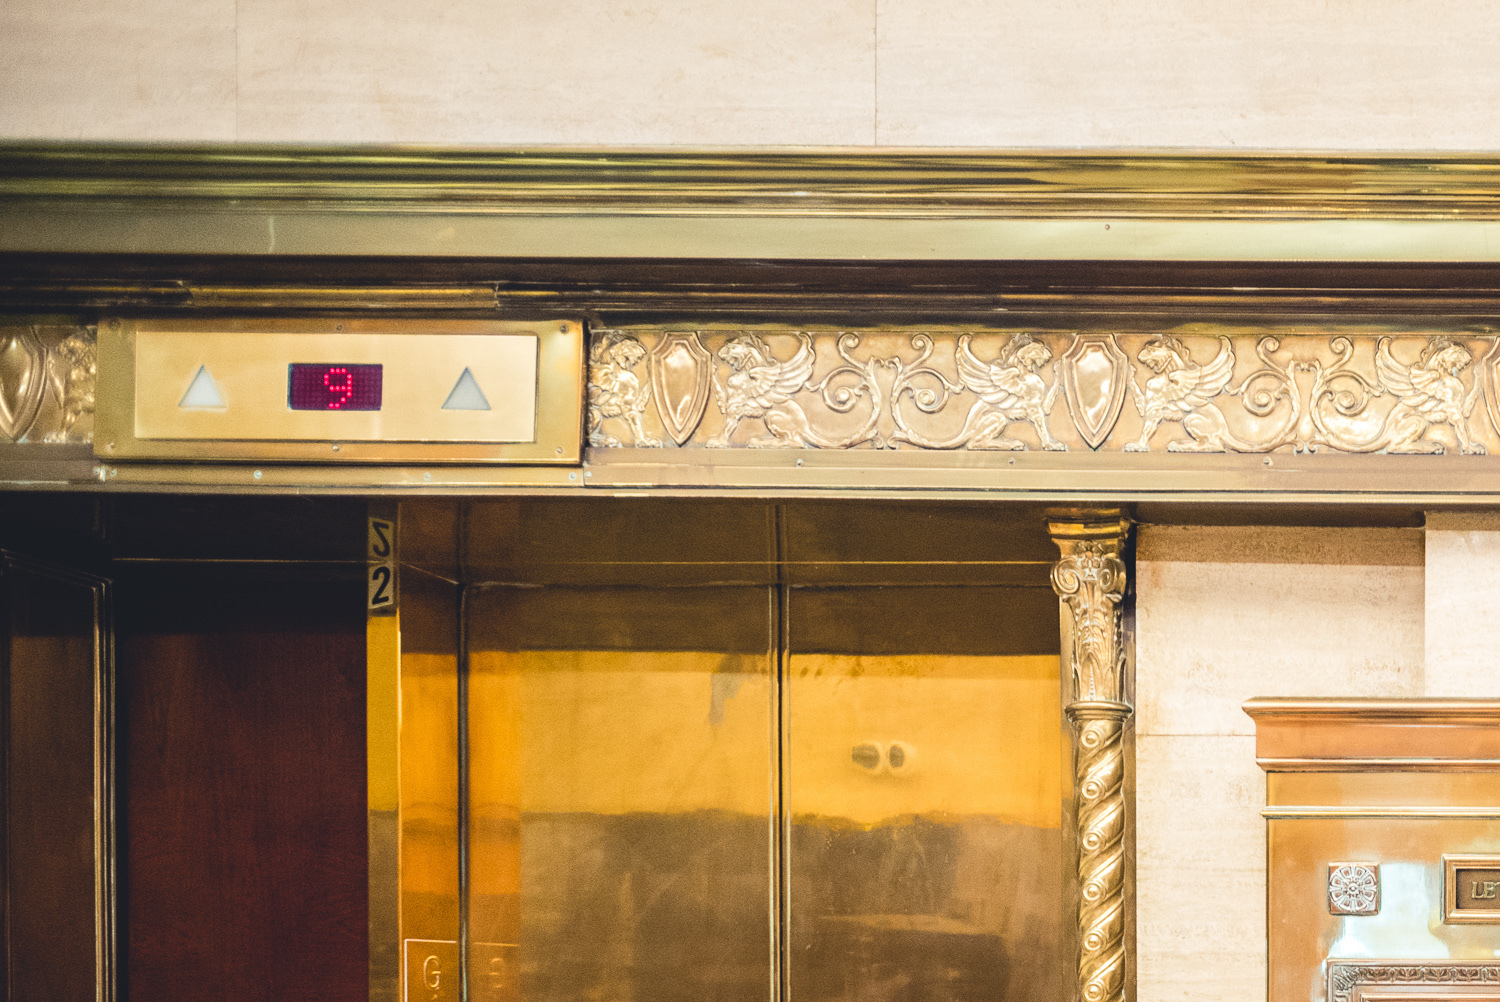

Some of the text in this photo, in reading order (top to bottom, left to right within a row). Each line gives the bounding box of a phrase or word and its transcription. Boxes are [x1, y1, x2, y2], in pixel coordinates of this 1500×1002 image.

[323, 367, 353, 410] 9
[372, 566, 391, 605] 2
[423, 955, 442, 989] G
